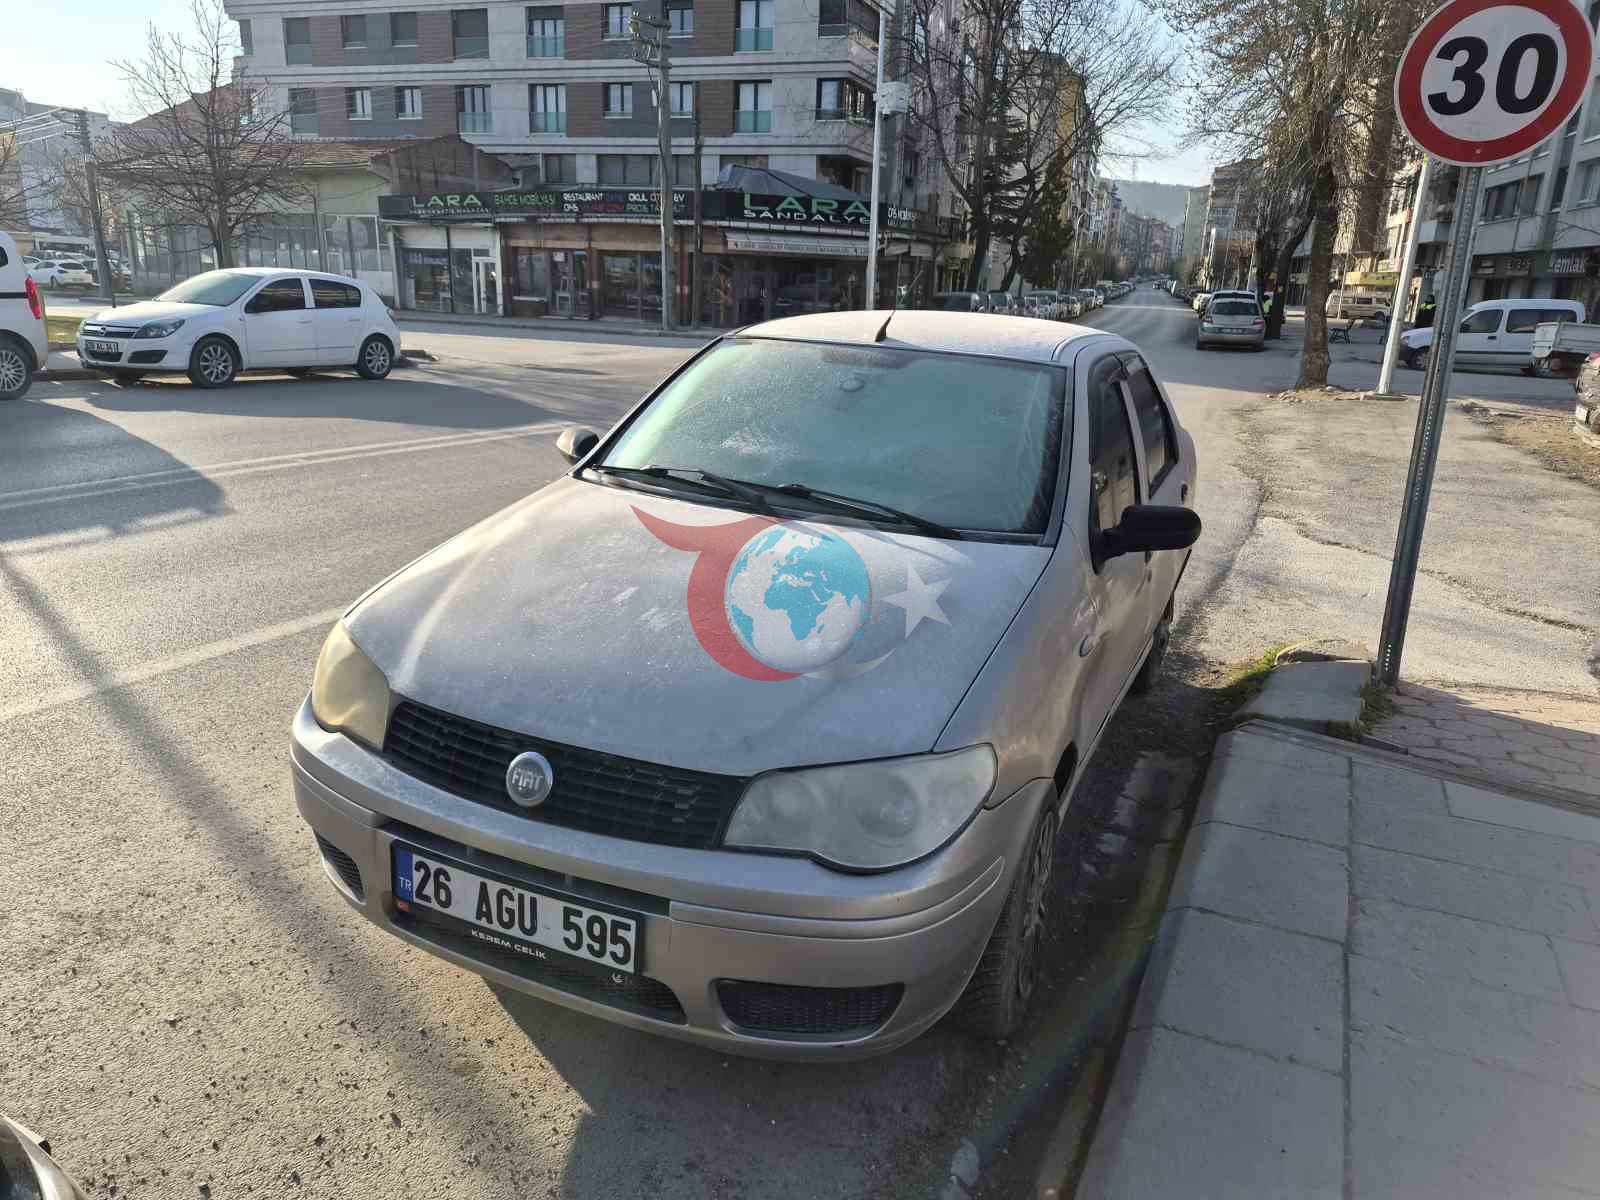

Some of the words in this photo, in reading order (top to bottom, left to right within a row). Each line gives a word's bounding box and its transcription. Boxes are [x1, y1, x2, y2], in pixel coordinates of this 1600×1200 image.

[1427, 33, 1559, 116] 30
[412, 194, 482, 208] LARA
[562, 192, 604, 202] RESTAURANT
[743, 192, 871, 217] LARA
[743, 209, 872, 225] SANDALYE
[399, 876, 412, 890] TR
[413, 860, 453, 909] 26
[475, 881, 538, 937] AGU
[562, 906, 632, 967] 595
[471, 928, 512, 948] KEREM
